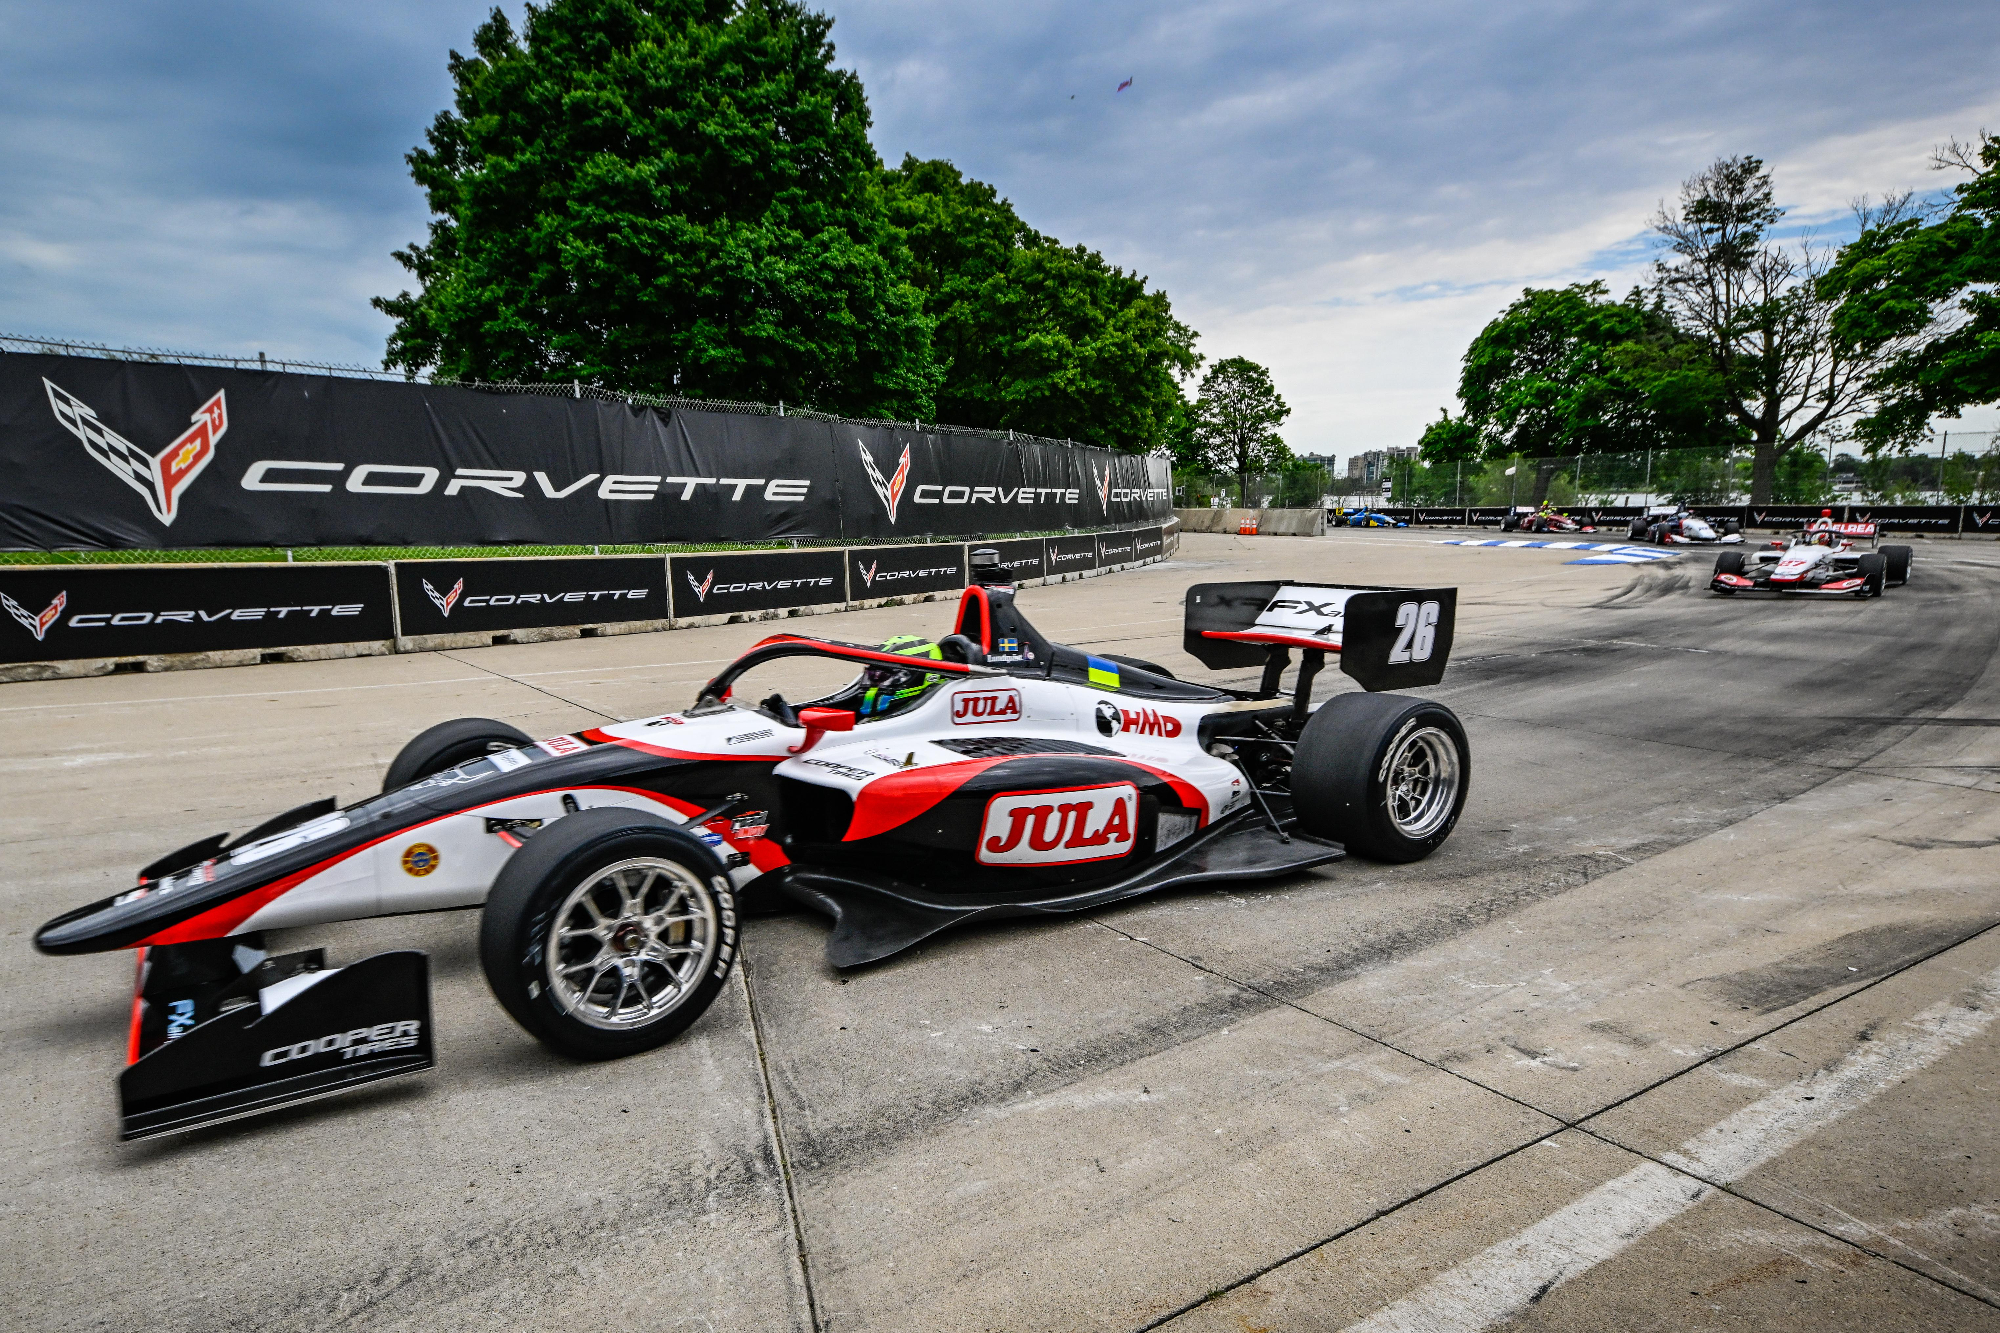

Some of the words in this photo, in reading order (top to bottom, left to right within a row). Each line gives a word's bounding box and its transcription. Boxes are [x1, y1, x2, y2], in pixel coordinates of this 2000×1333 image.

[241, 459, 812, 502] CORVETTE
[913, 484, 1080, 504] CORVETTE
[1110, 488, 1168, 502] CORVETTE
[1056, 551, 1093, 561] CORVETTE
[711, 577, 834, 594] CORVETTE
[876, 566, 957, 582] CORVETTE
[462, 588, 649, 608] CORVETTE
[67, 603, 365, 628] CORVETTE
[1387, 600, 1441, 666] 26
[955, 694, 1019, 719] JULA
[1119, 706, 1183, 739] HMD
[802, 758, 877, 777] COOPER
[985, 796, 1132, 854] JULA
[710, 874, 736, 980] COOPER
[258, 1019, 422, 1068] COOPER
[339, 1035, 419, 1060] TIRES
